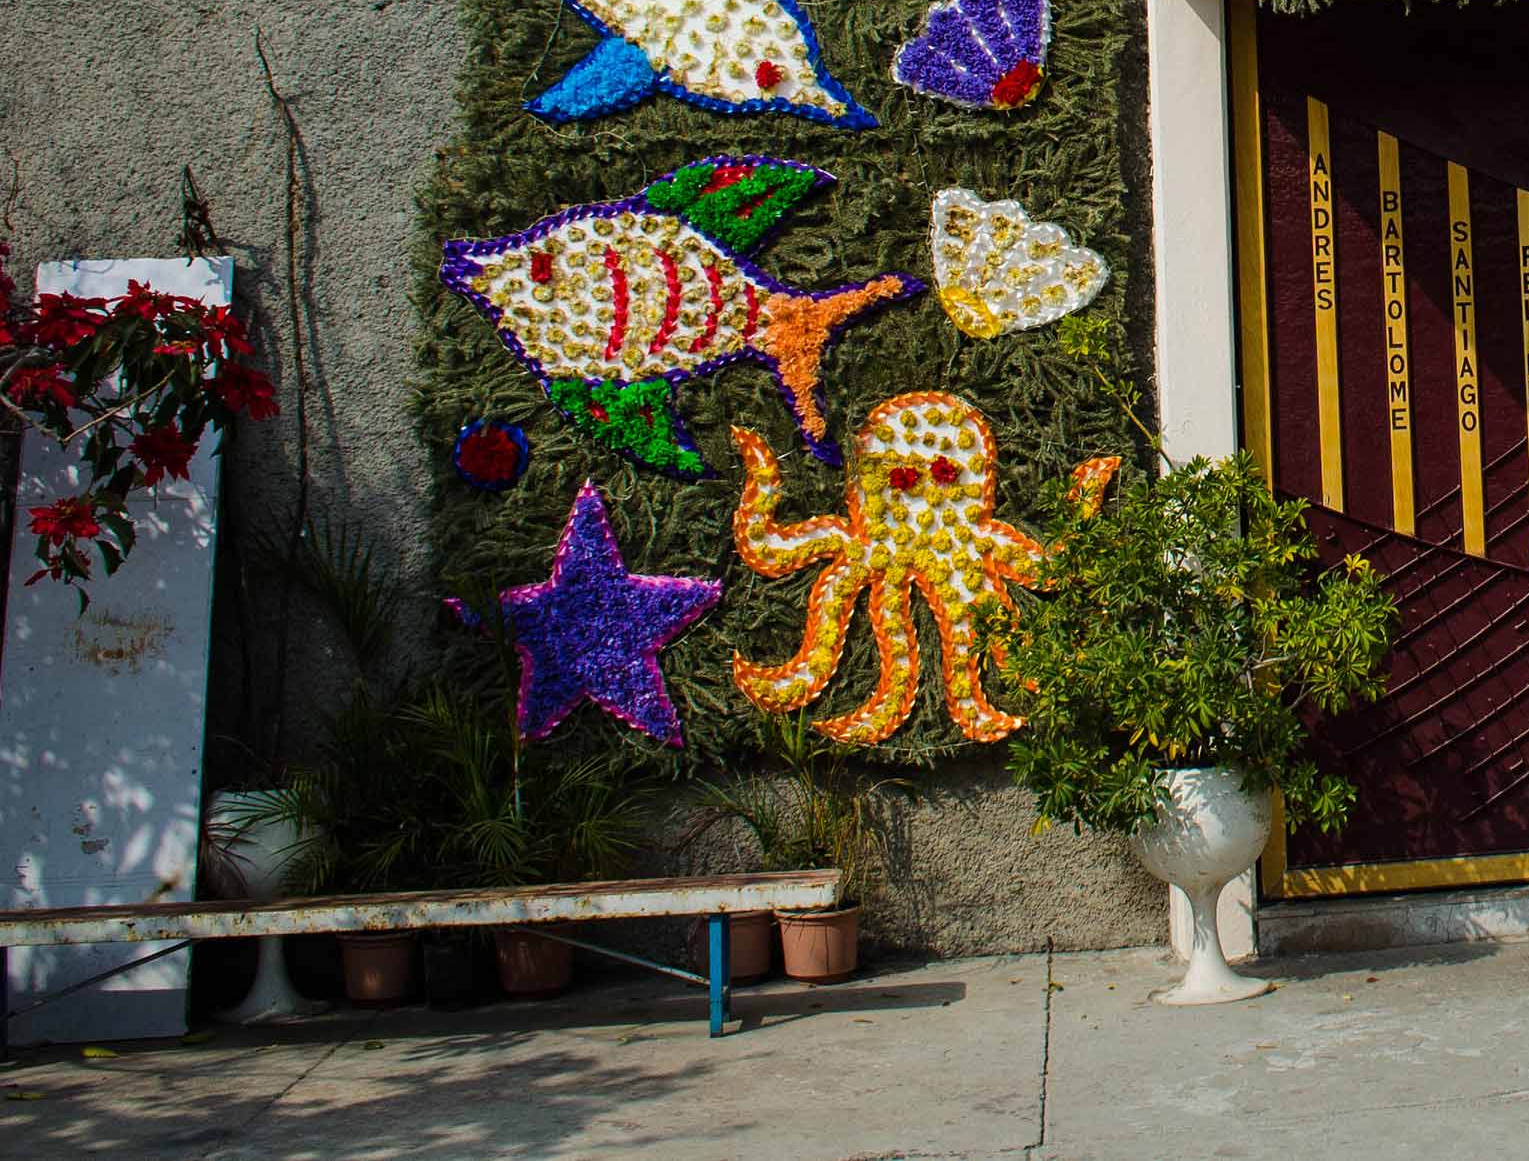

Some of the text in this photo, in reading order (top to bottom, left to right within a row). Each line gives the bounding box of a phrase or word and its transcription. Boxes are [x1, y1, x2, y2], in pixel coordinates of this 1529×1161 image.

[1312, 153, 1333, 311] ANDRES
[1382, 190, 1408, 431] BARTOLOME
[1453, 221, 1478, 433] SANTIAGO
